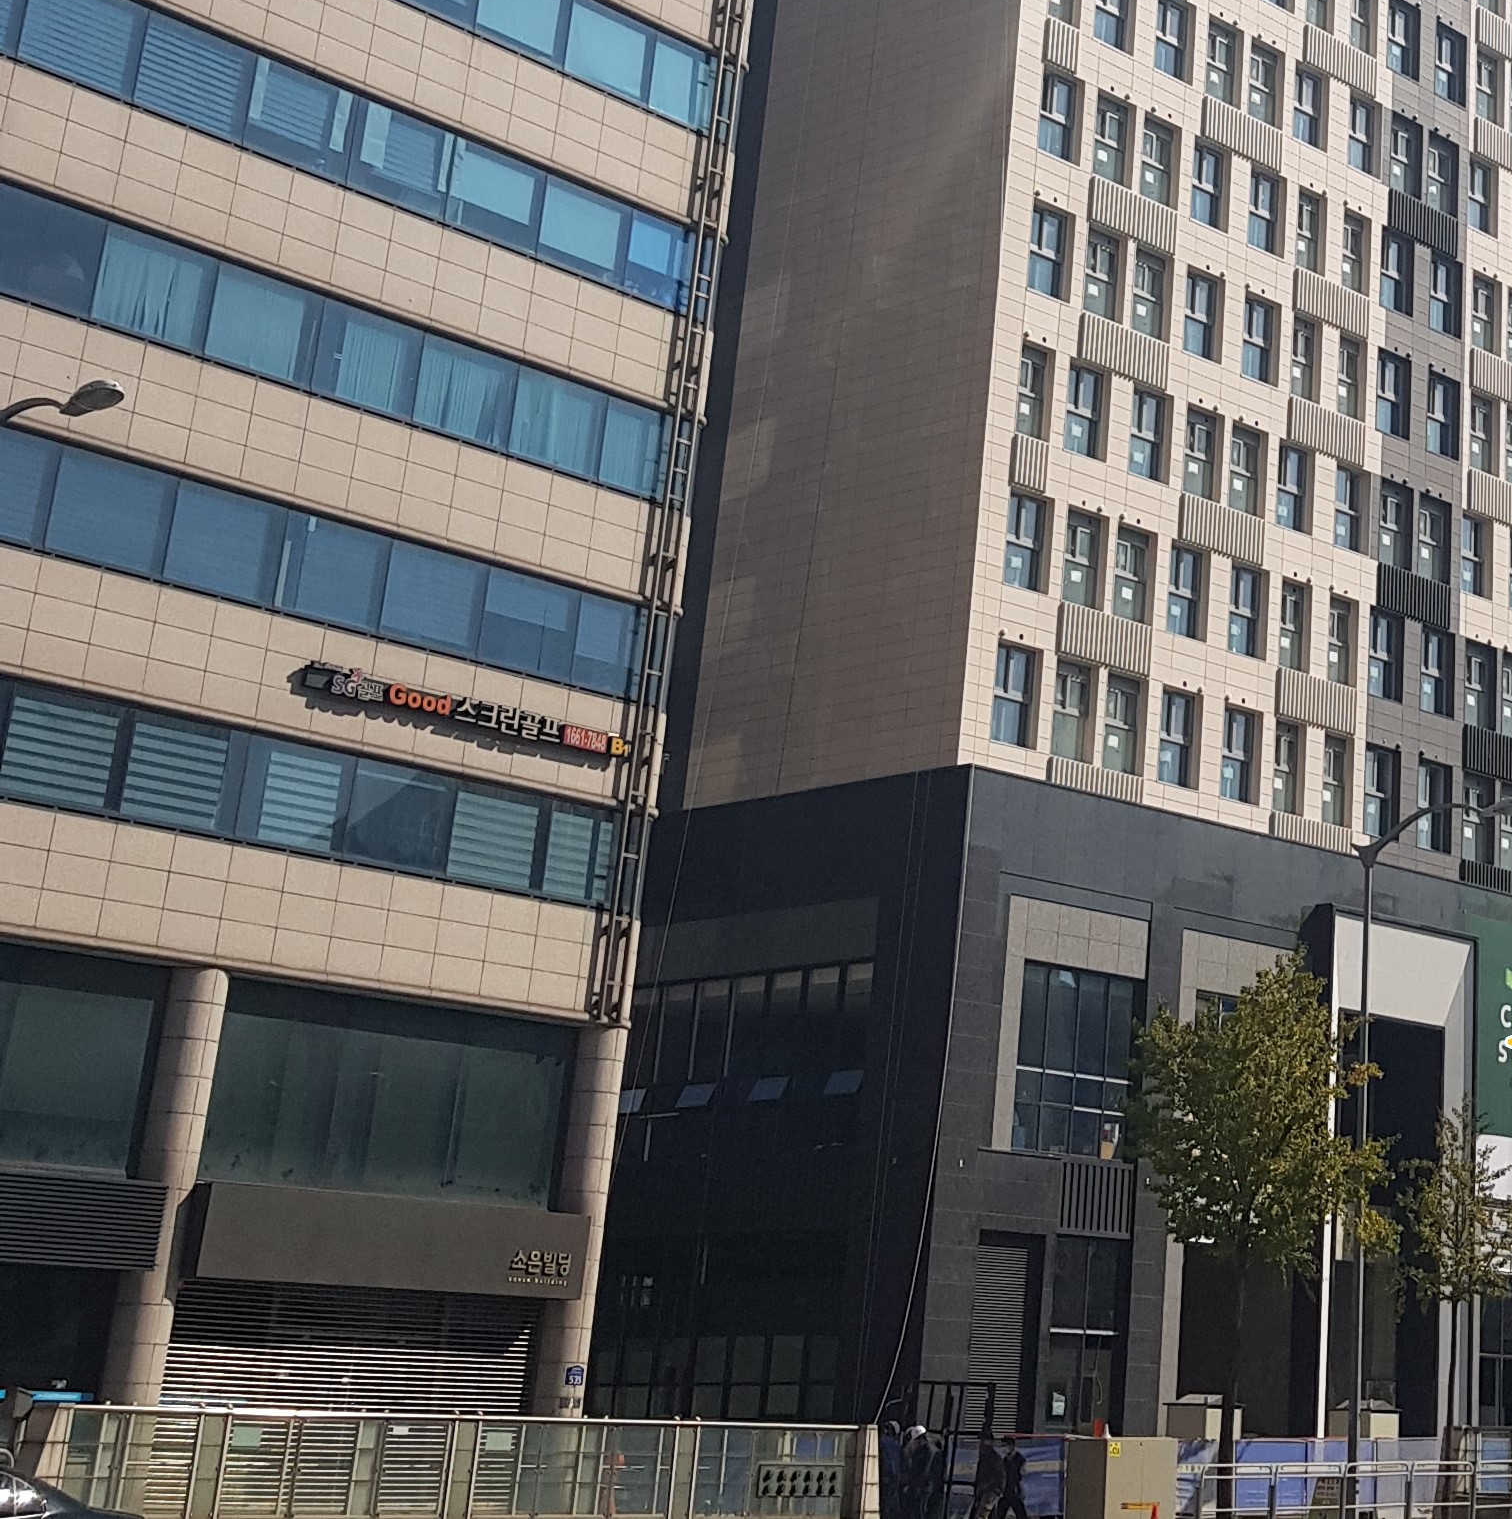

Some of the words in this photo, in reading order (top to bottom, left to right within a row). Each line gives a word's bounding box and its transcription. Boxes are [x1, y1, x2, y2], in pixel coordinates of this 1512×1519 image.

[389, 682, 453, 717] Good
[454, 696, 561, 743] 스크린골프
[511, 1249, 572, 1276] 소은빌딩
